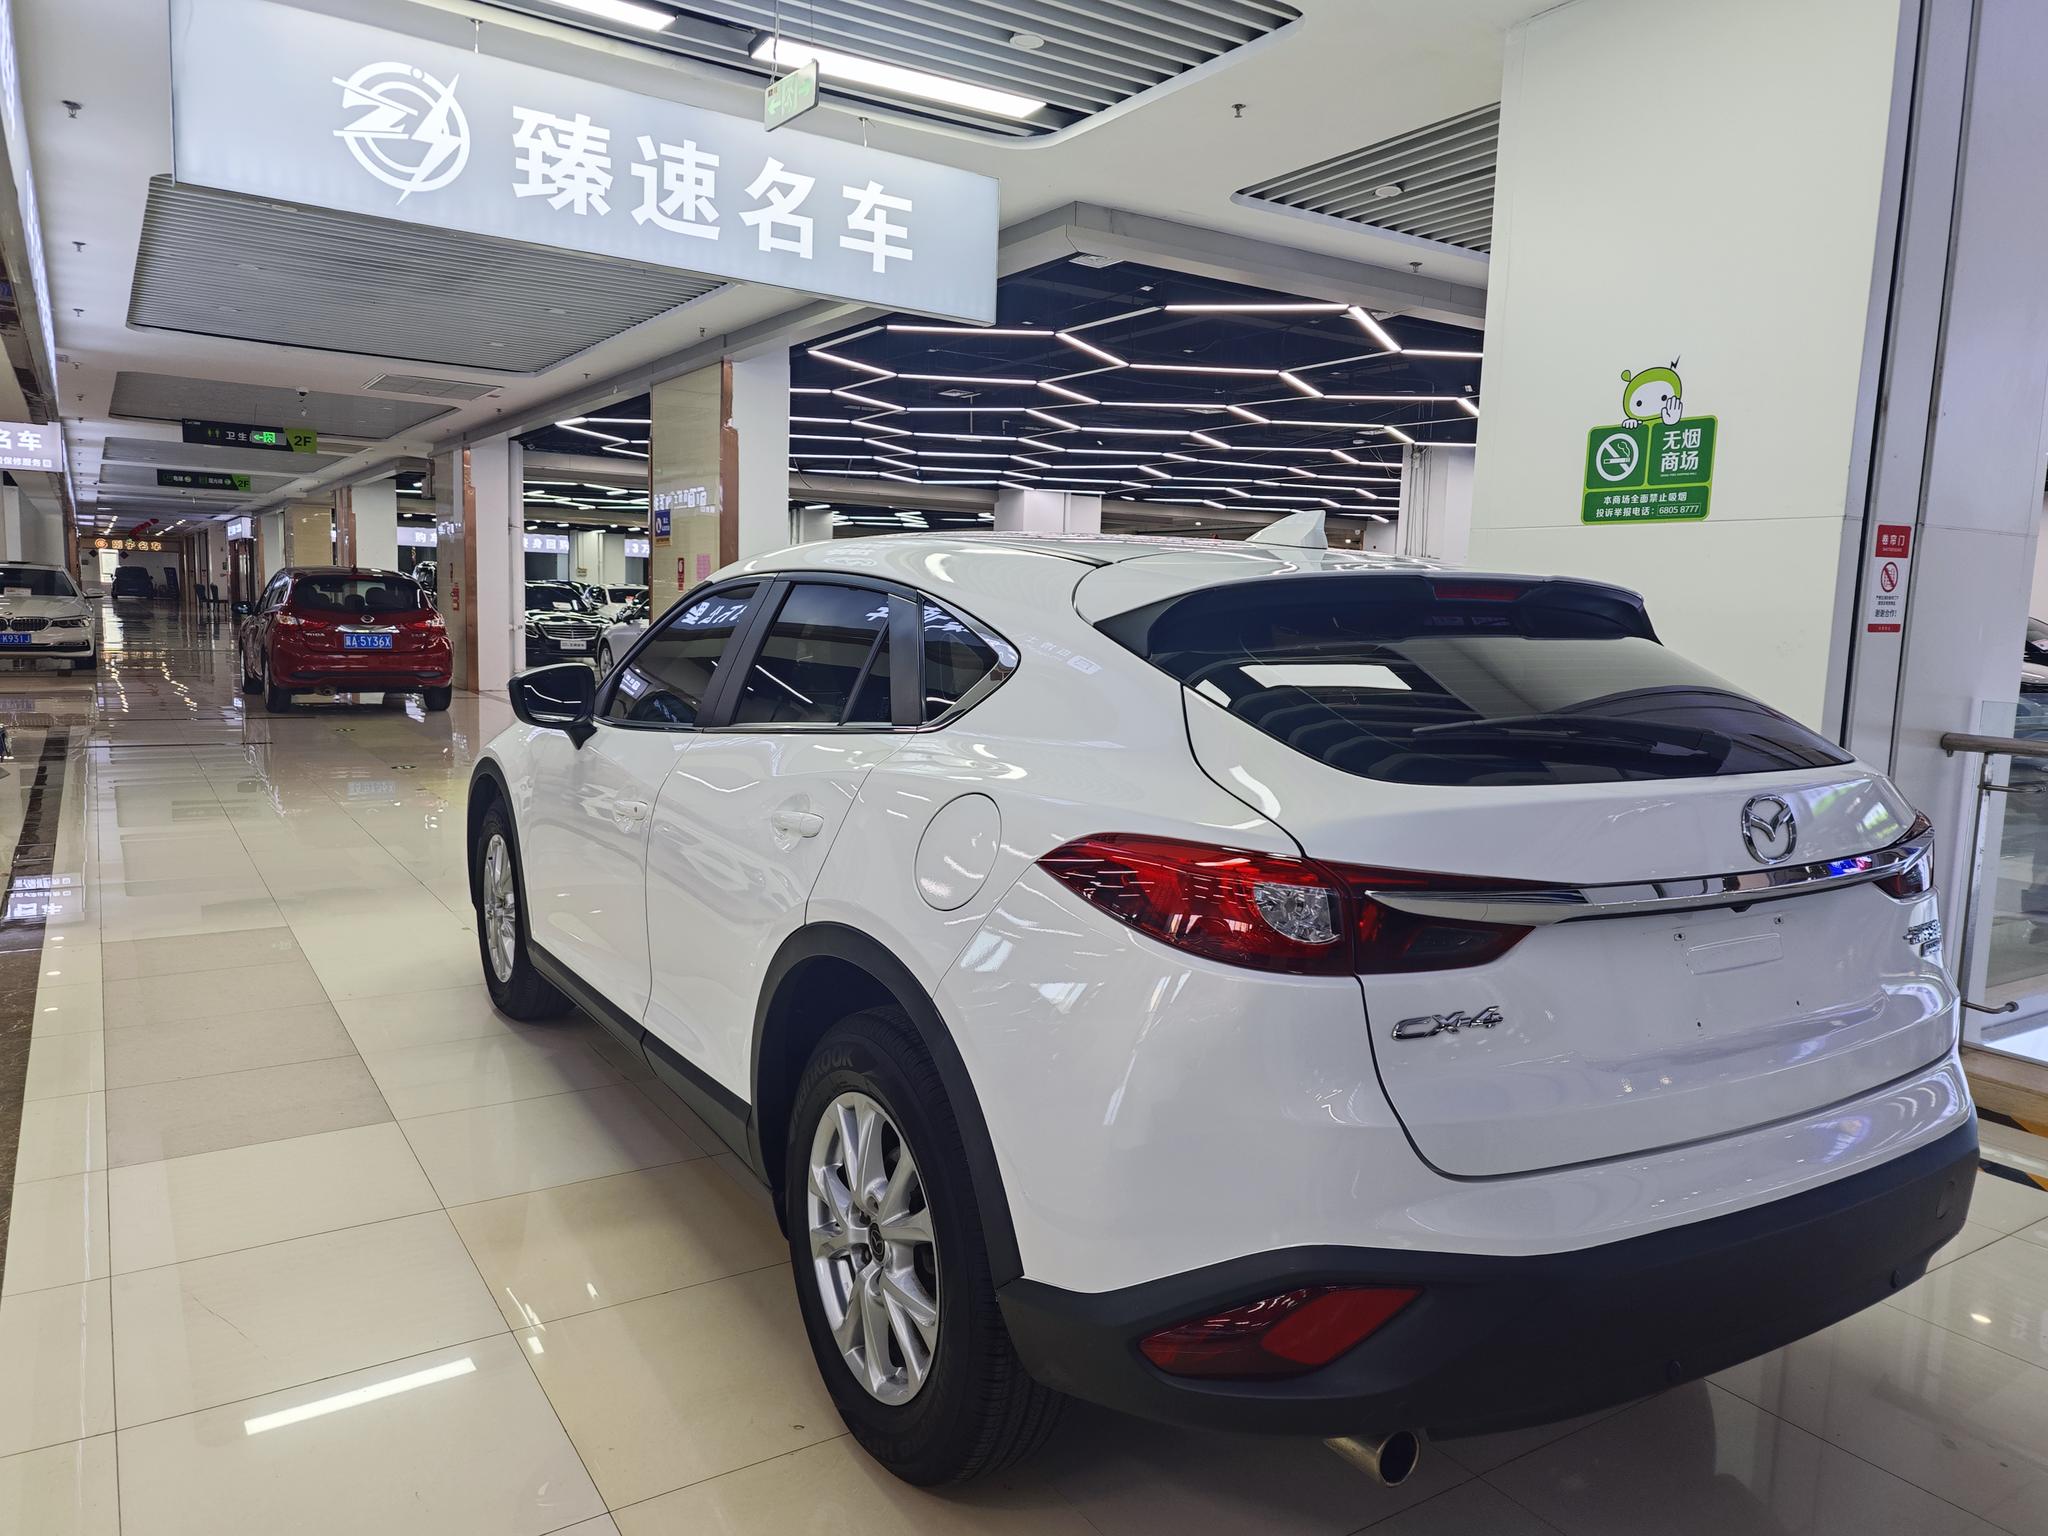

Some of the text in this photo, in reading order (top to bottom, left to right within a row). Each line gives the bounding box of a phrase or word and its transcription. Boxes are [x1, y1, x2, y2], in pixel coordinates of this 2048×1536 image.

[511, 105, 913, 274] 臻速名车
[294, 434, 312, 447] 2F
[1662, 428, 1702, 451] 无烟
[1660, 450, 1699, 473] 商场
[237, 479, 250, 488] 2F
[1603, 492, 1688, 505] 本商场全面禁止吸烟
[1659, 506, 1679, 515] 6805
[1680, 504, 1700, 514] 8777
[1391, 1005, 1504, 1041] CX-4
